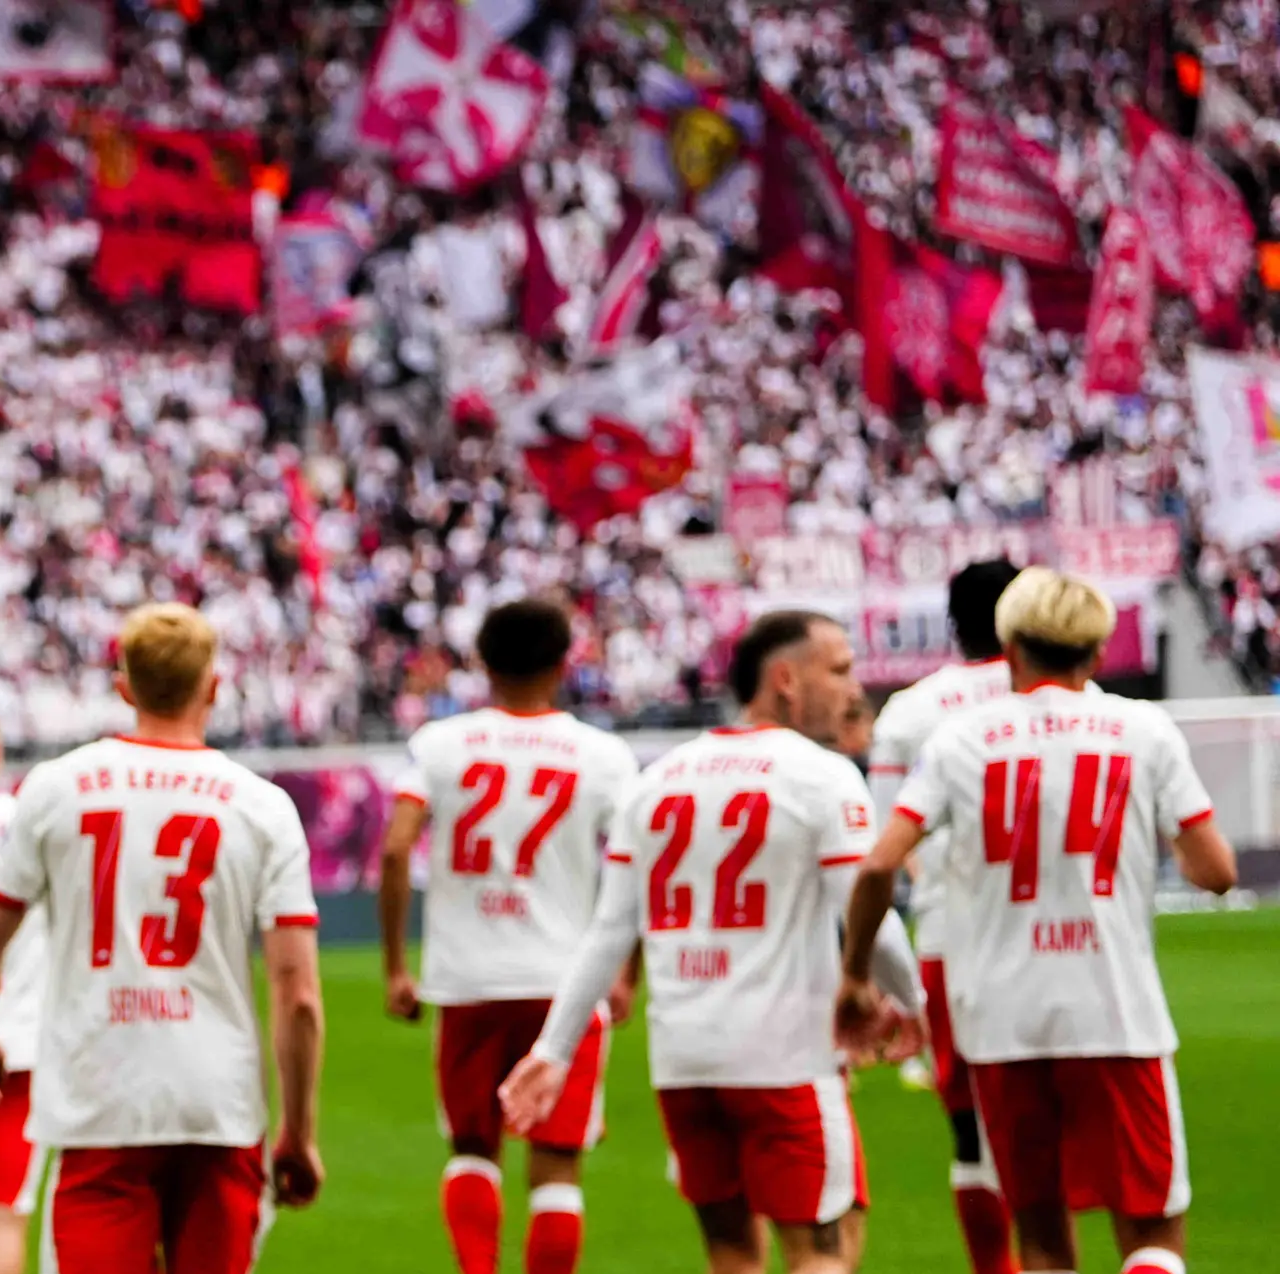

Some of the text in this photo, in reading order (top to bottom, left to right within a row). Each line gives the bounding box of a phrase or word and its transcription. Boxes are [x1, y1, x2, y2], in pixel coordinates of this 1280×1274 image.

[127, 768, 235, 804] LEIPZIG
[451, 761, 578, 878] 27
[981, 753, 1133, 904] 44
[79, 809, 222, 970] 13
[647, 791, 772, 932] 22
